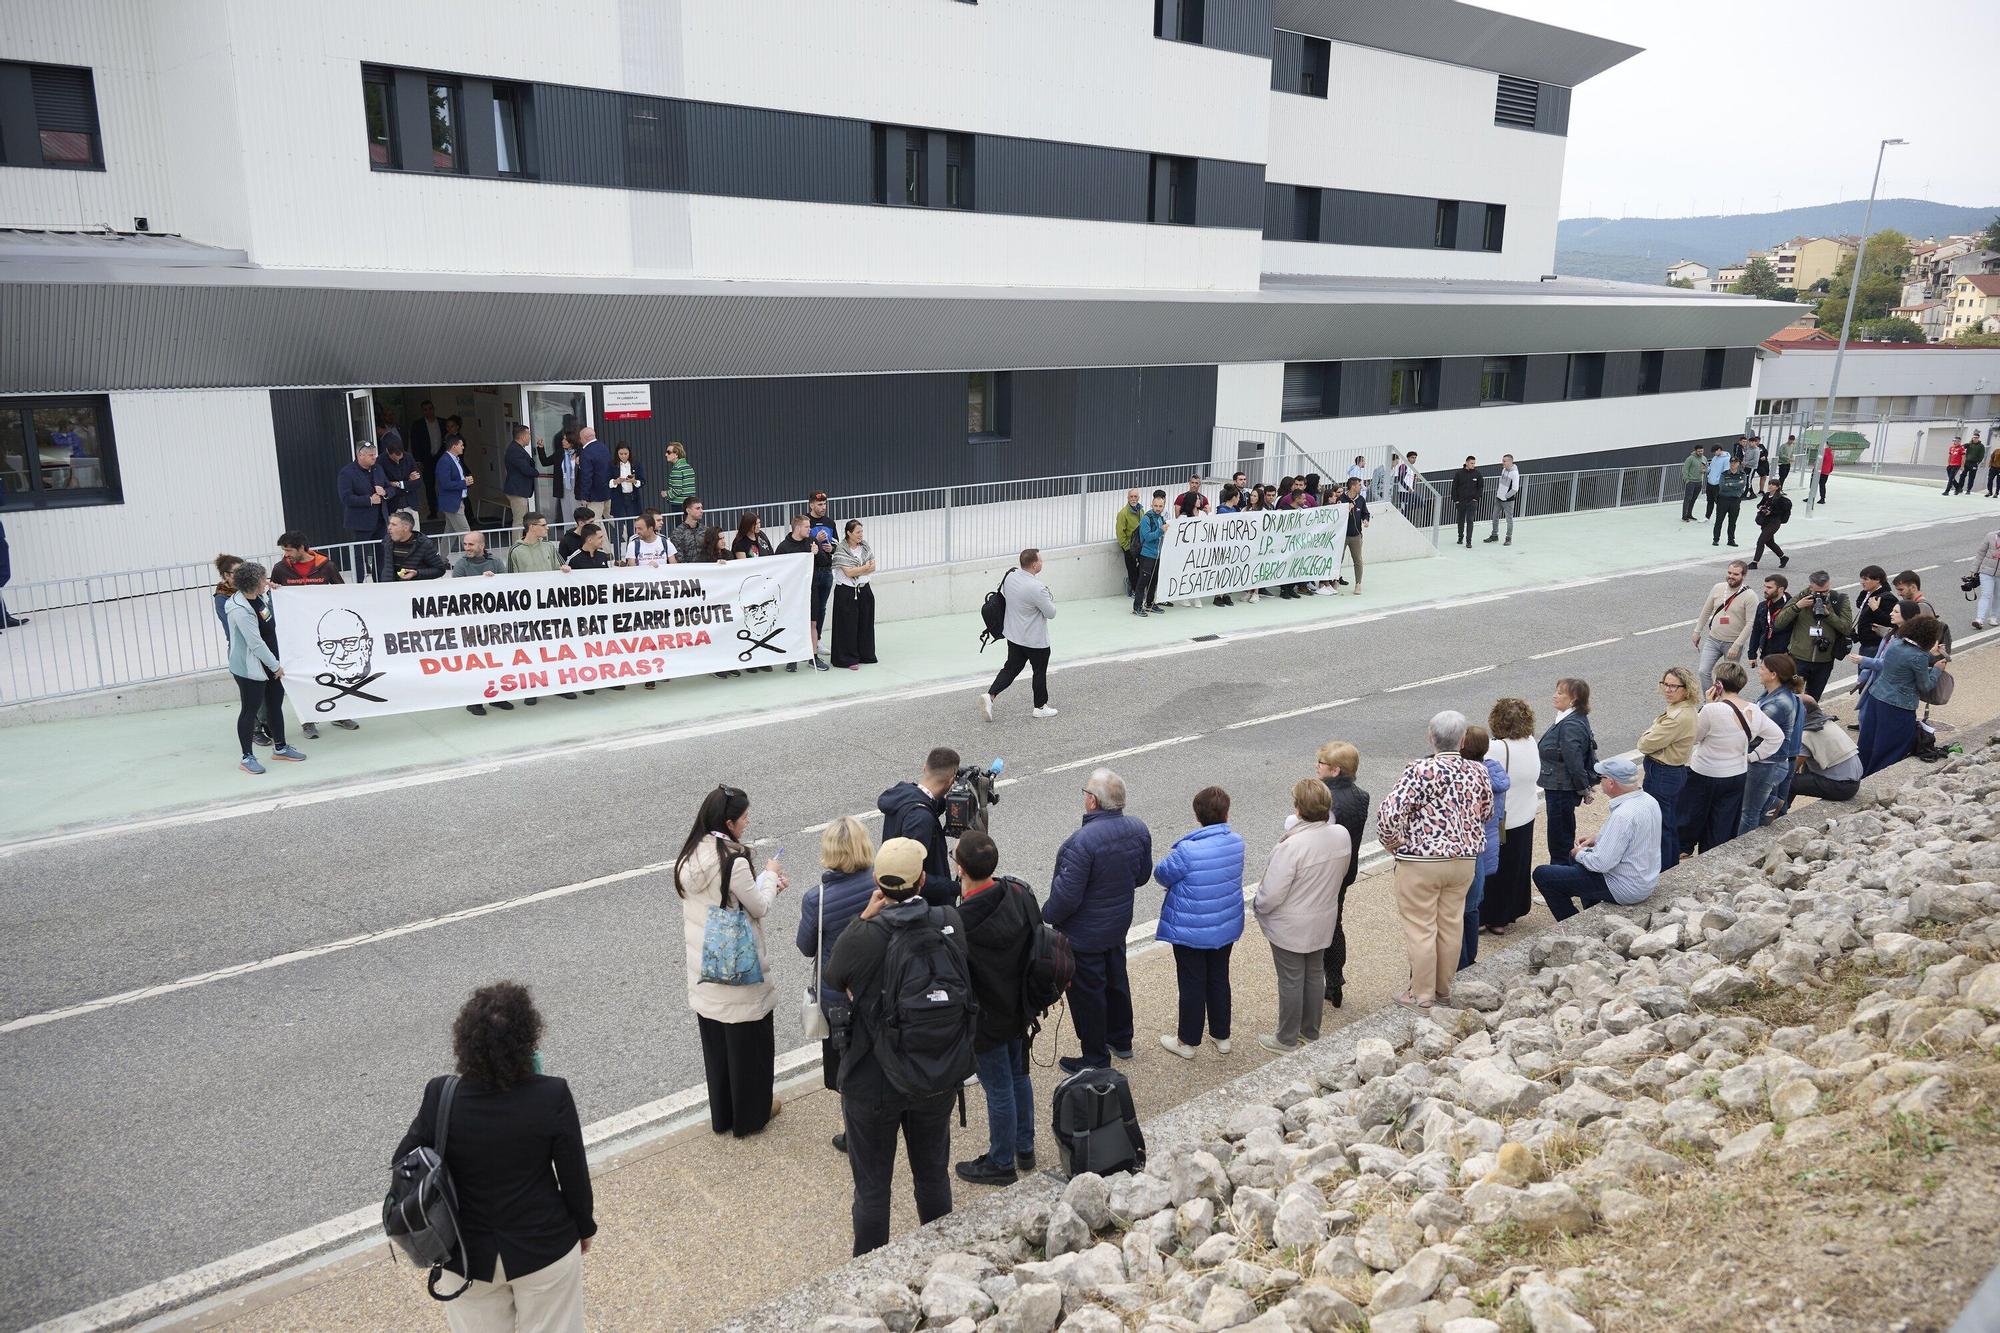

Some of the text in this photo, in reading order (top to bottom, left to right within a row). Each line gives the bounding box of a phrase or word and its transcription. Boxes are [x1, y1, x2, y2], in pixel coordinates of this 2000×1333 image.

[1175, 520, 1257, 547] FCT SIN HORAS
[1182, 545, 1251, 572] ALUMNADO
[412, 578, 706, 619] NAFARROAKO LANBIDE HEZIKETAN,
[1168, 564, 1250, 597] DESATENDIDO
[383, 603, 734, 655] BERTZE MURRIZKETA BAT EZARRI DIGUTE
[419, 630, 712, 675] DUAL A LA NAVARRA
[483, 657, 665, 698] ¿SIN HORAS?
